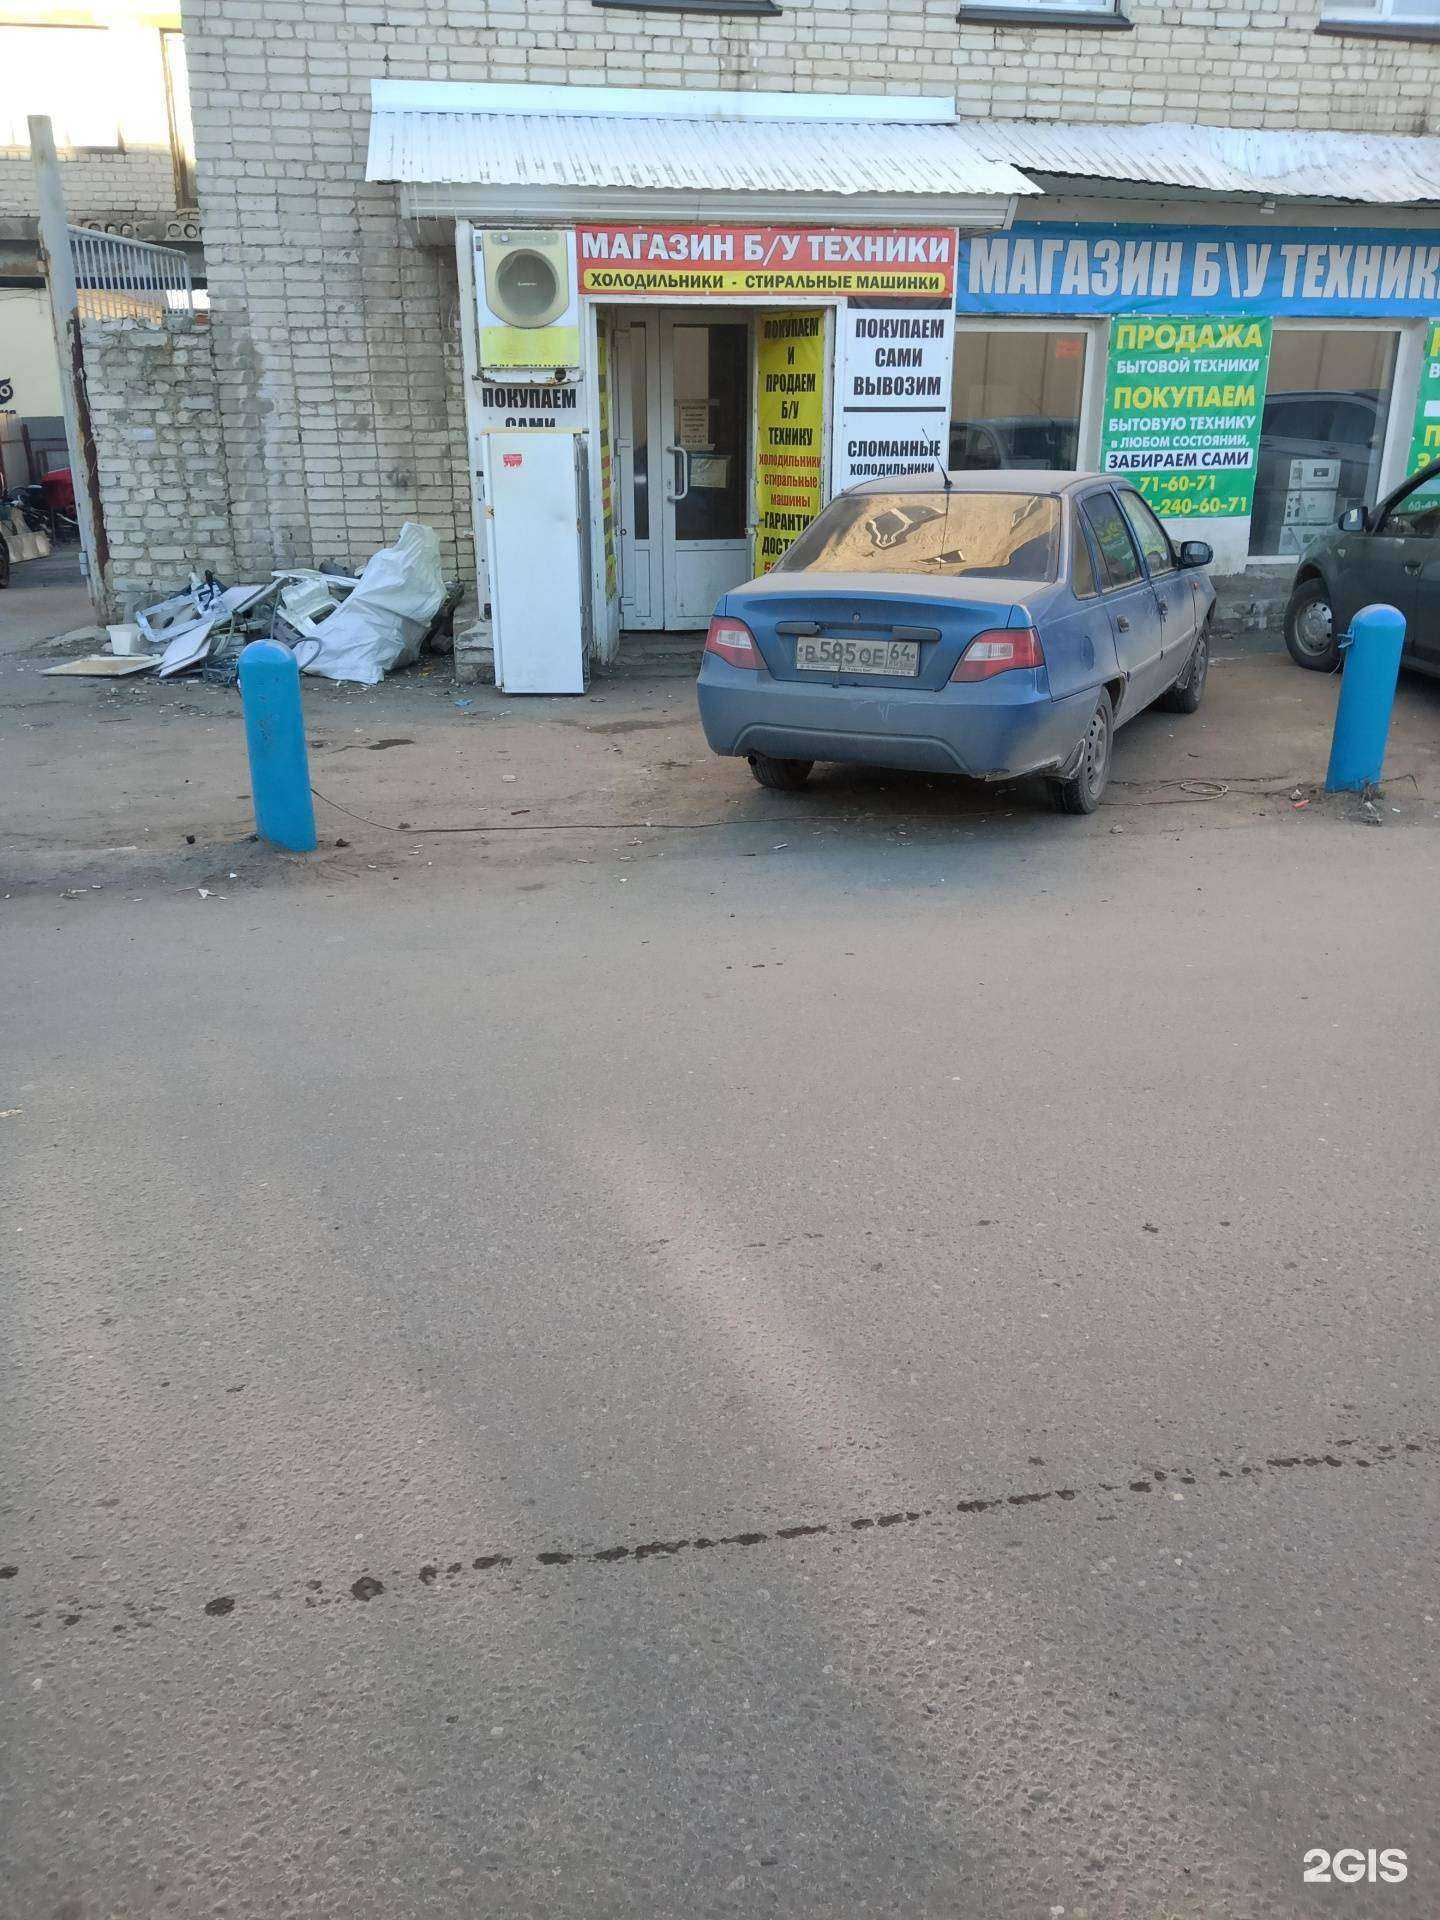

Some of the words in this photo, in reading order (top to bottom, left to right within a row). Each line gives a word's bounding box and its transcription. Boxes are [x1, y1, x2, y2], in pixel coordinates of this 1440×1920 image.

[581, 232, 734, 261] МАГАЗИН
[744, 234, 800, 266] Б/У
[807, 235, 950, 262] ТЕХНИКИ
[968, 238, 1184, 297] МАГАЗИН
[1191, 242, 1272, 298] Б\У
[1280, 244, 1440, 299] ТЕХНИК
[590, 272, 724, 289] ХОЛОДИЛЬНИКИ
[745, 273, 852, 289] СТИРАЛЬНЫЕ
[856, 275, 940, 290] МАШИНКИ
[764, 318, 819, 339] ПОКУПАЕМ
[855, 318, 944, 338] ПОКУПАЕМ
[1116, 323, 1263, 353] ПРОДАЖА
[787, 346, 795, 365] И
[875, 347, 923, 367] САМИ
[1116, 357, 1190, 374] БЫТОВОЙ
[1193, 359, 1260, 373] ТЕХНИКИ
[765, 373, 816, 395] ПРОДАЕМ
[853, 376, 941, 396] ВЫВОЗИМ
[481, 387, 577, 408] ПОКУПАЕМ
[1113, 384, 1256, 410] ПОКУПАЕМ
[781, 400, 799, 419] Б/У
[1109, 418, 1187, 432] БЫТОВУЮ
[1190, 415, 1256, 430] ТЕХНИКУ
[768, 427, 814, 446] ТЕХНИКУ
[1120, 436, 1170, 448] ЛЮБОМ
[1172, 434, 1250, 448] СОСТОЯНИИ,
[848, 440, 941, 457] СЛОМАННЫЕ
[1109, 454, 1197, 469] ЗАБИРАЕМ
[1202, 451, 1248, 467] САМИ
[764, 474, 817, 488] стиральные
[1139, 475, 1216, 493] 71-60-71
[770, 494, 810, 507] машины
[1149, 497, 1248, 515] -240-60-71
[764, 512, 815, 532] ГАРАНТИ
[762, 537, 796, 556] ДОСТ
[805, 641, 885, 666] В585ОЕ
[889, 643, 912, 661] 64
